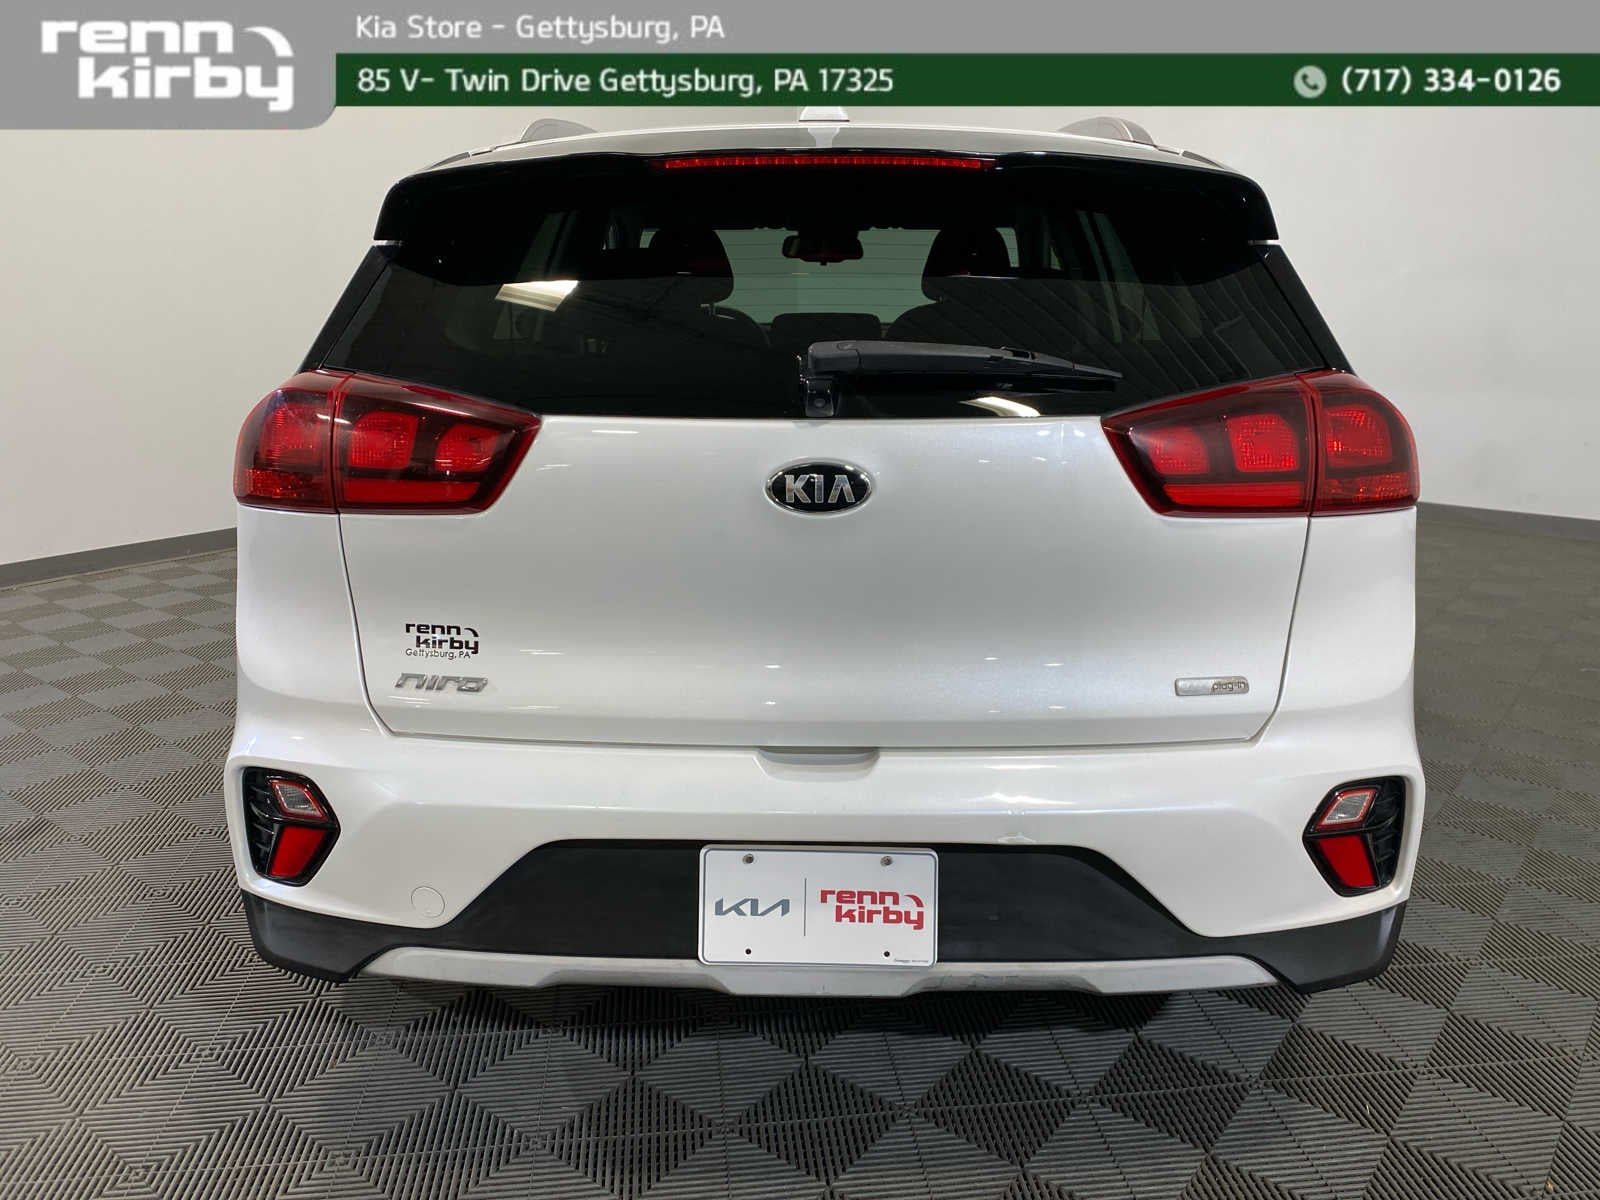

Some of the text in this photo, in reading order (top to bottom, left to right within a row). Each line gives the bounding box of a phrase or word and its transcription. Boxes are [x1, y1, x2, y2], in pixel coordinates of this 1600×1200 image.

[784, 474, 856, 503] KIA
[405, 623, 462, 635] renn
[416, 635, 479, 654] kirby
[405, 648, 471, 660] Gettysburg, PA
[820, 889, 900, 905] renn
[835, 905, 925, 930] kirby
